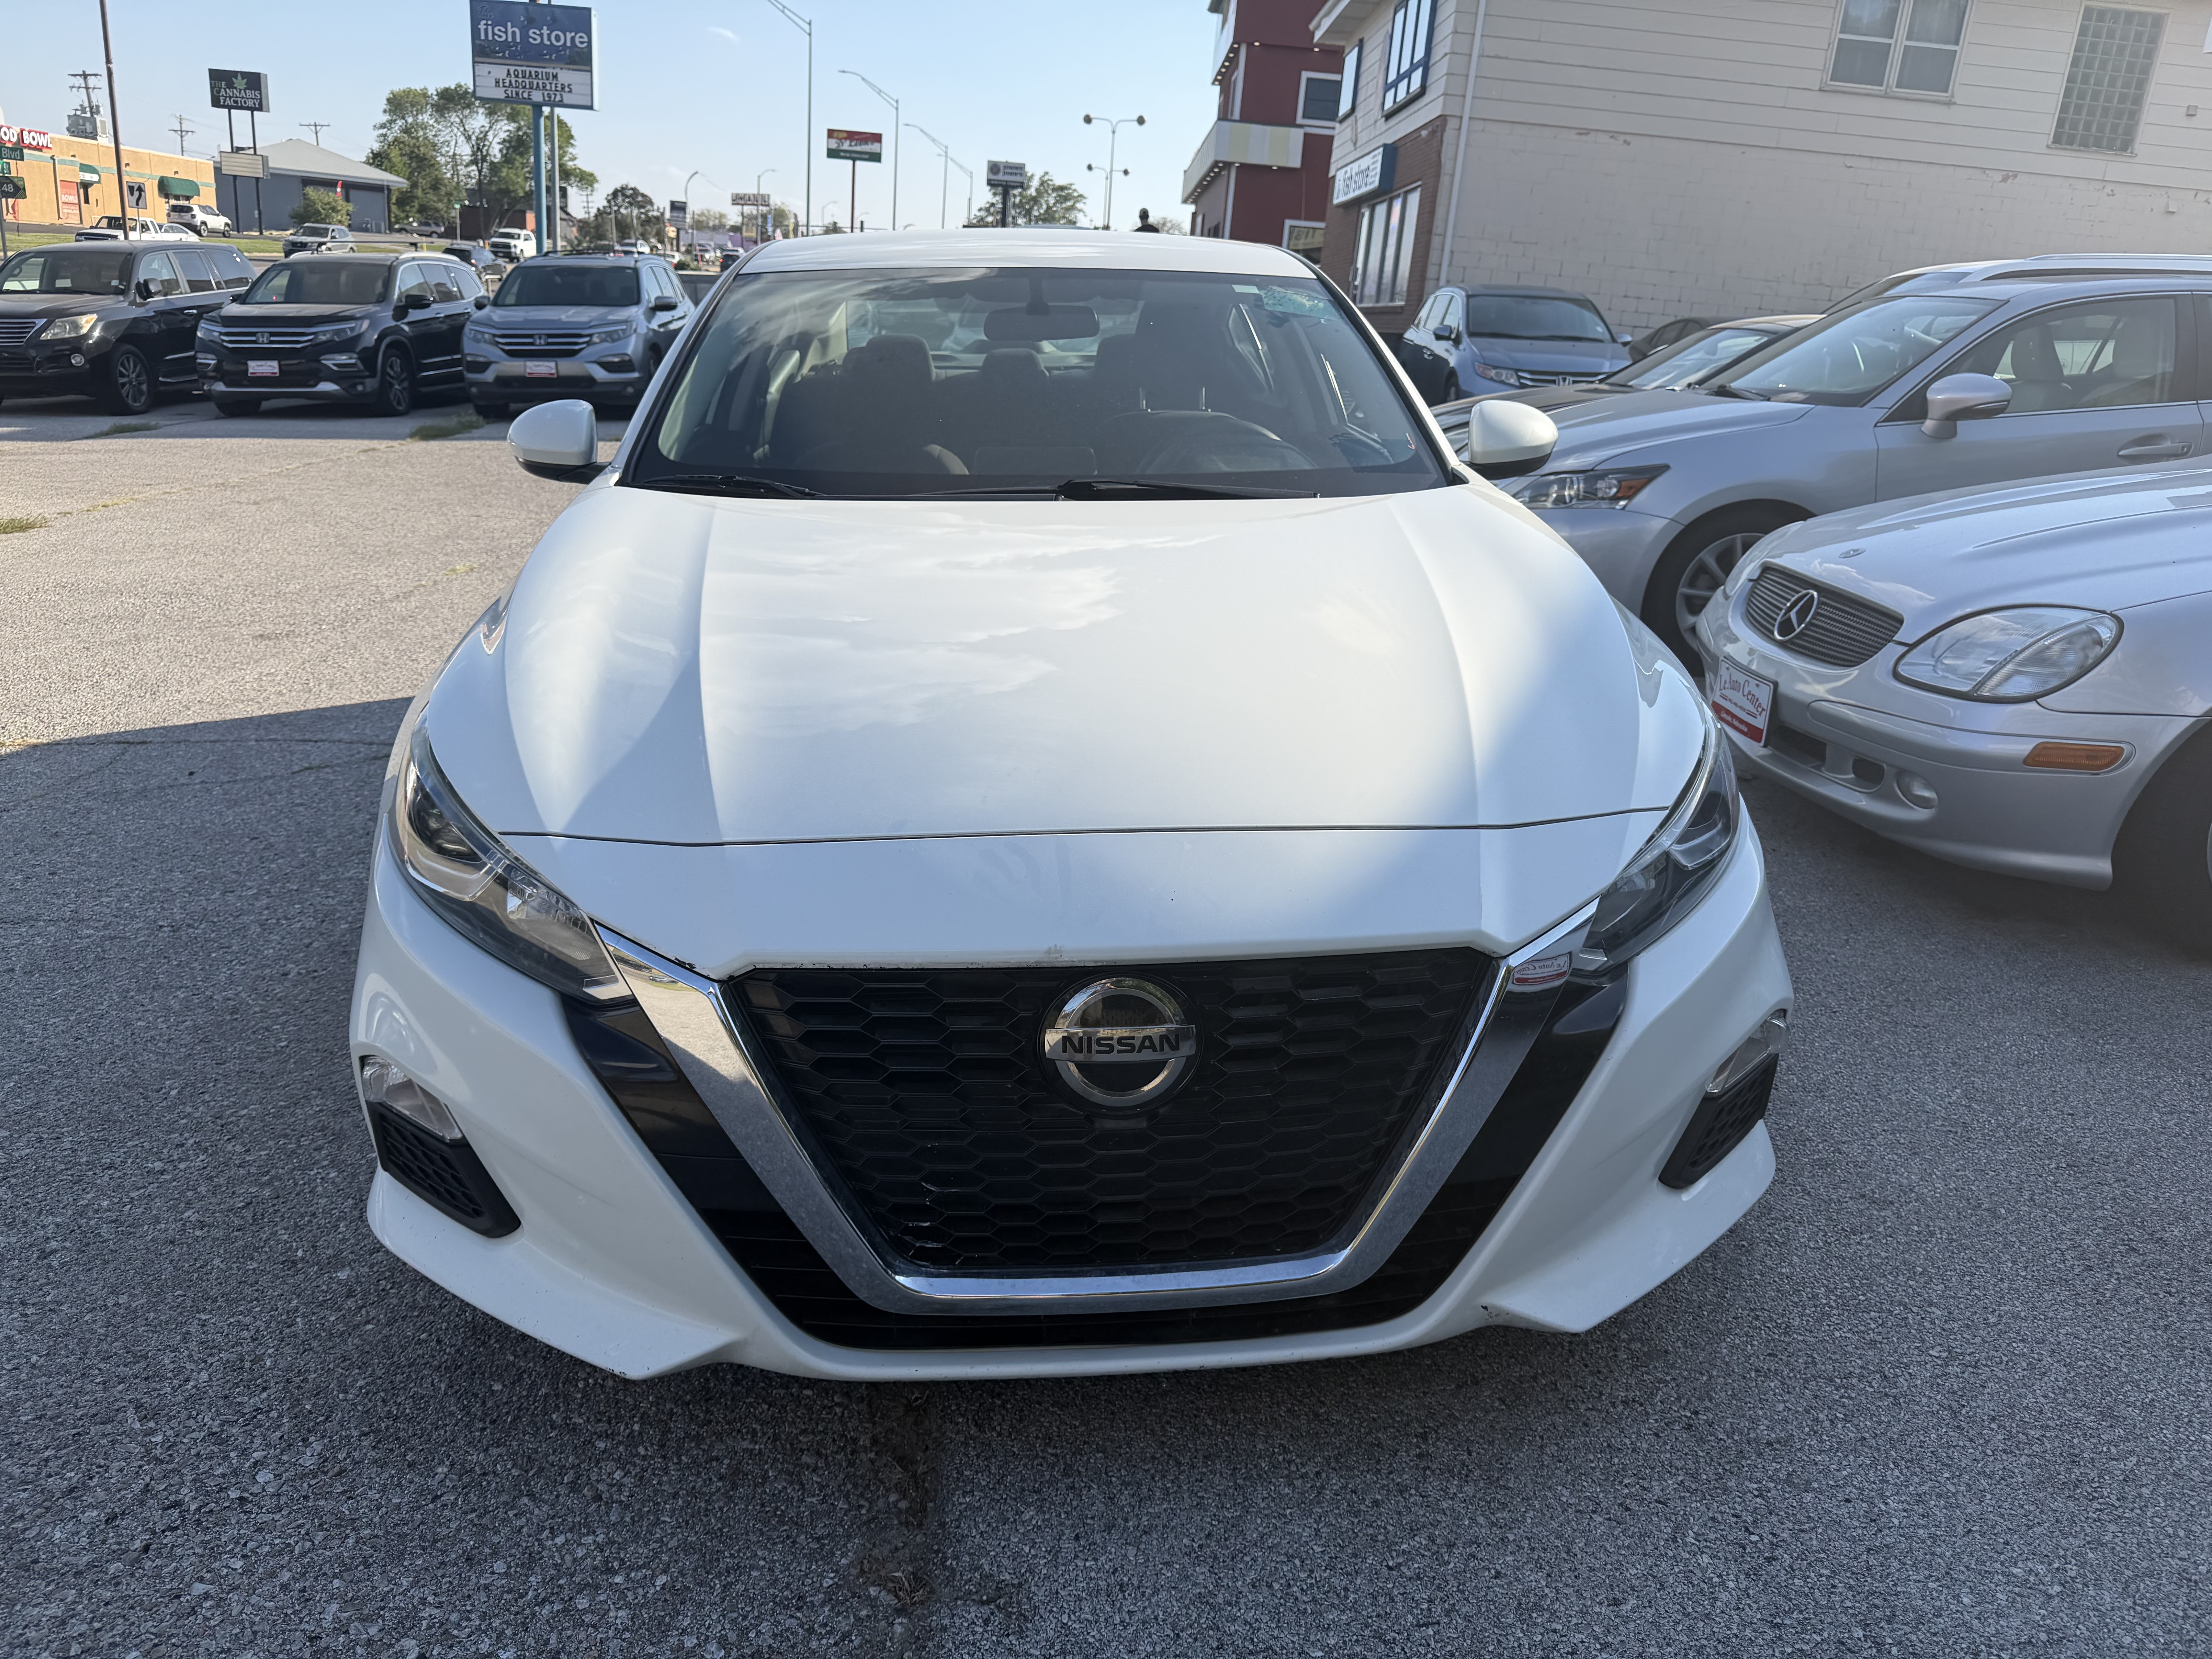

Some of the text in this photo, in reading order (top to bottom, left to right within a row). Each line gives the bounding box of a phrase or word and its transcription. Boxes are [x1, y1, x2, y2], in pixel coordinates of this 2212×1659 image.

[478, 20, 589, 48] fish store
[506, 68, 558, 81] AQUARIUM
[494, 78, 572, 93] HEADQUARTERS
[214, 88, 260, 99] CANNABIS
[504, 89, 564, 103] SINCE 1973
[219, 97, 260, 108] FACTORY
[0, 127, 53, 148] OD BOWL
[2, 148, 20, 159] Blvd
[2, 184, 14, 192] 48
[1719, 675, 1727, 691] Le
[1727, 672, 1741, 693] Auto
[1742, 679, 1765, 716] Center
[1061, 1033, 1180, 1054] NISSAN
